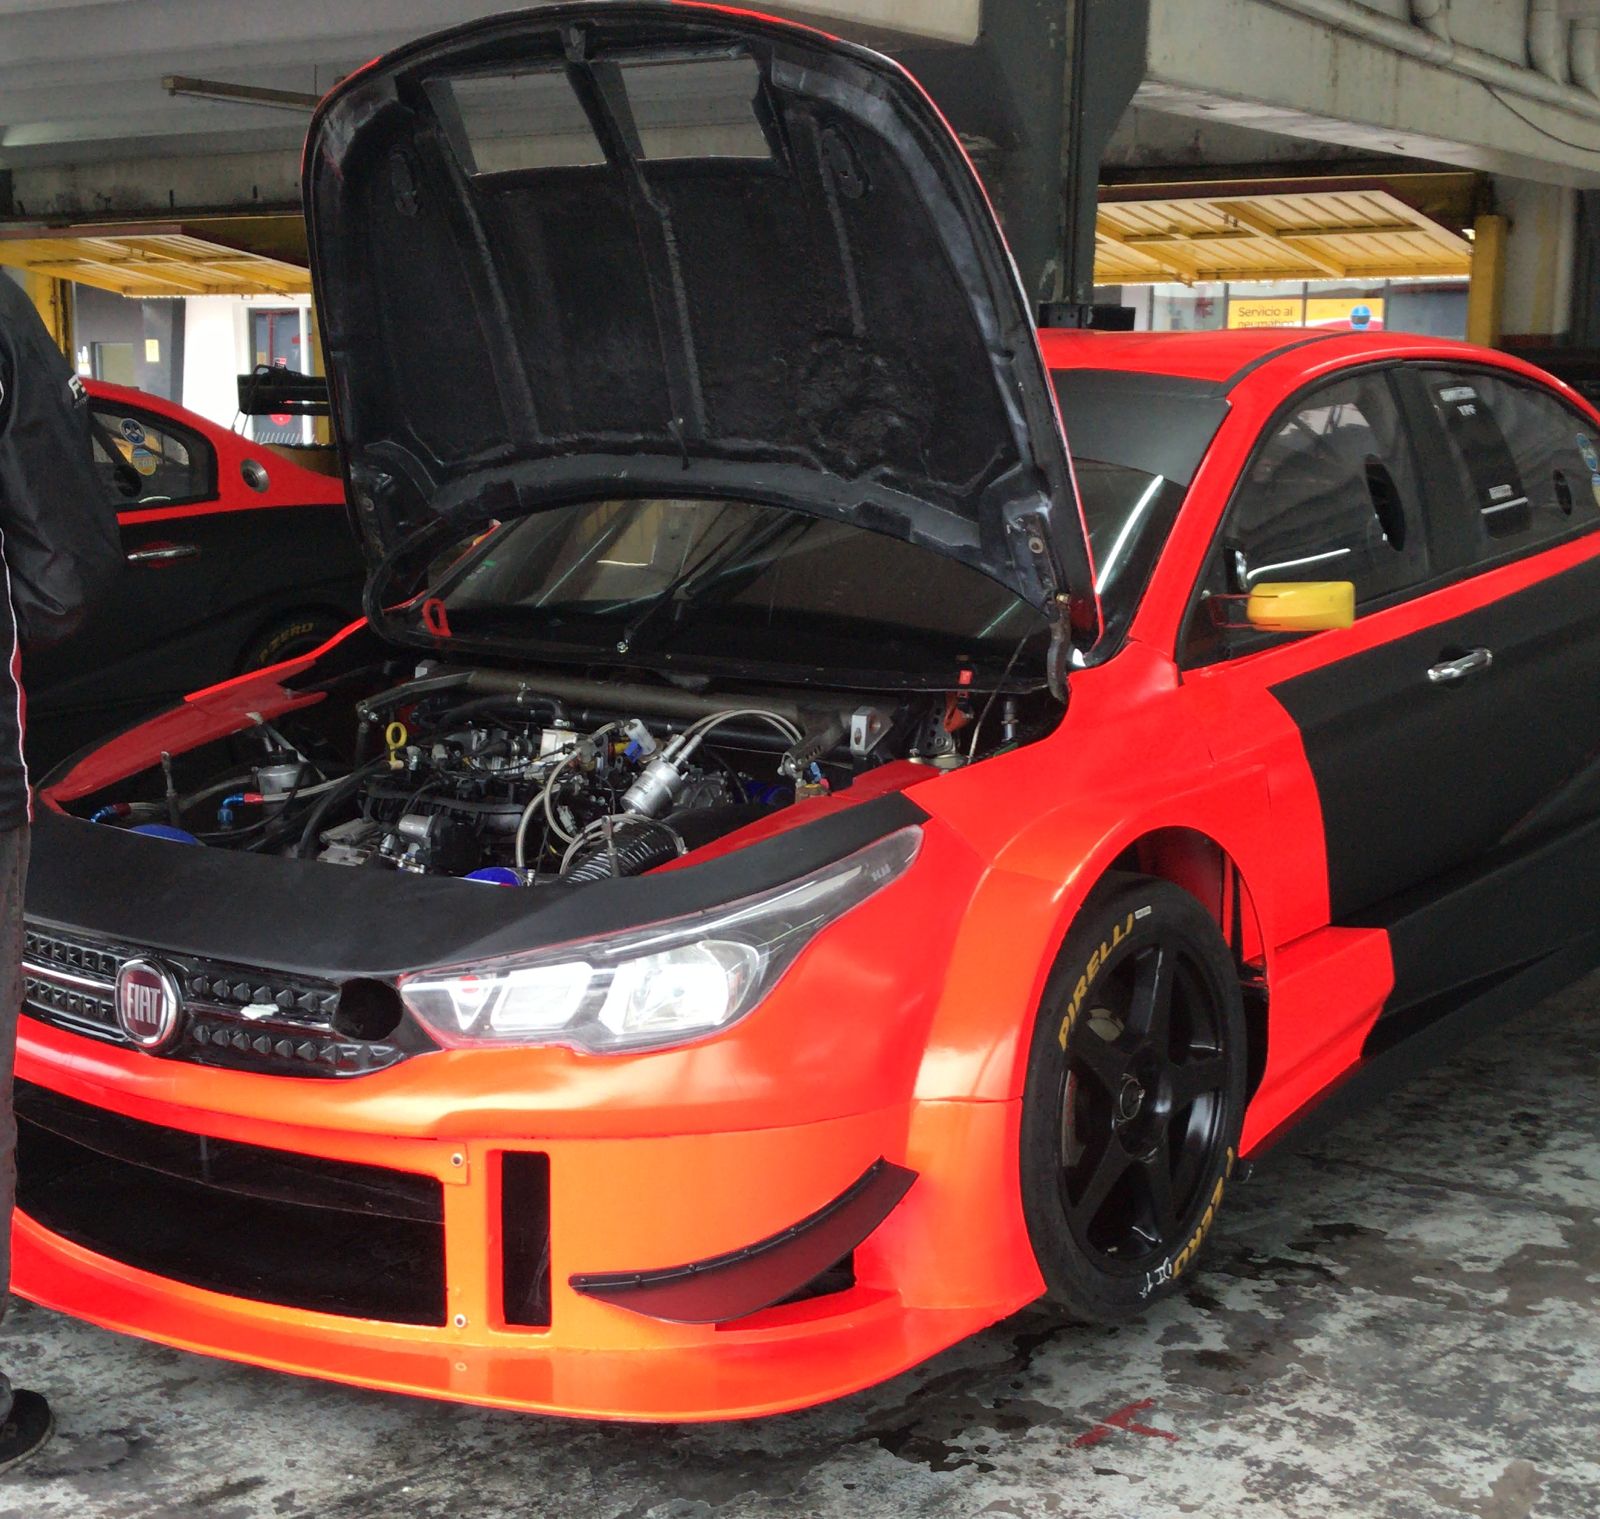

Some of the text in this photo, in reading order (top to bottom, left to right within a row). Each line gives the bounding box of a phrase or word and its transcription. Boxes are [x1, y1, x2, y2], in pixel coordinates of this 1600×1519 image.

[1238, 305, 1293, 317] Servicio al
[1058, 912, 1133, 1051] PIRELLI
[127, 982, 160, 1025] FIAT
